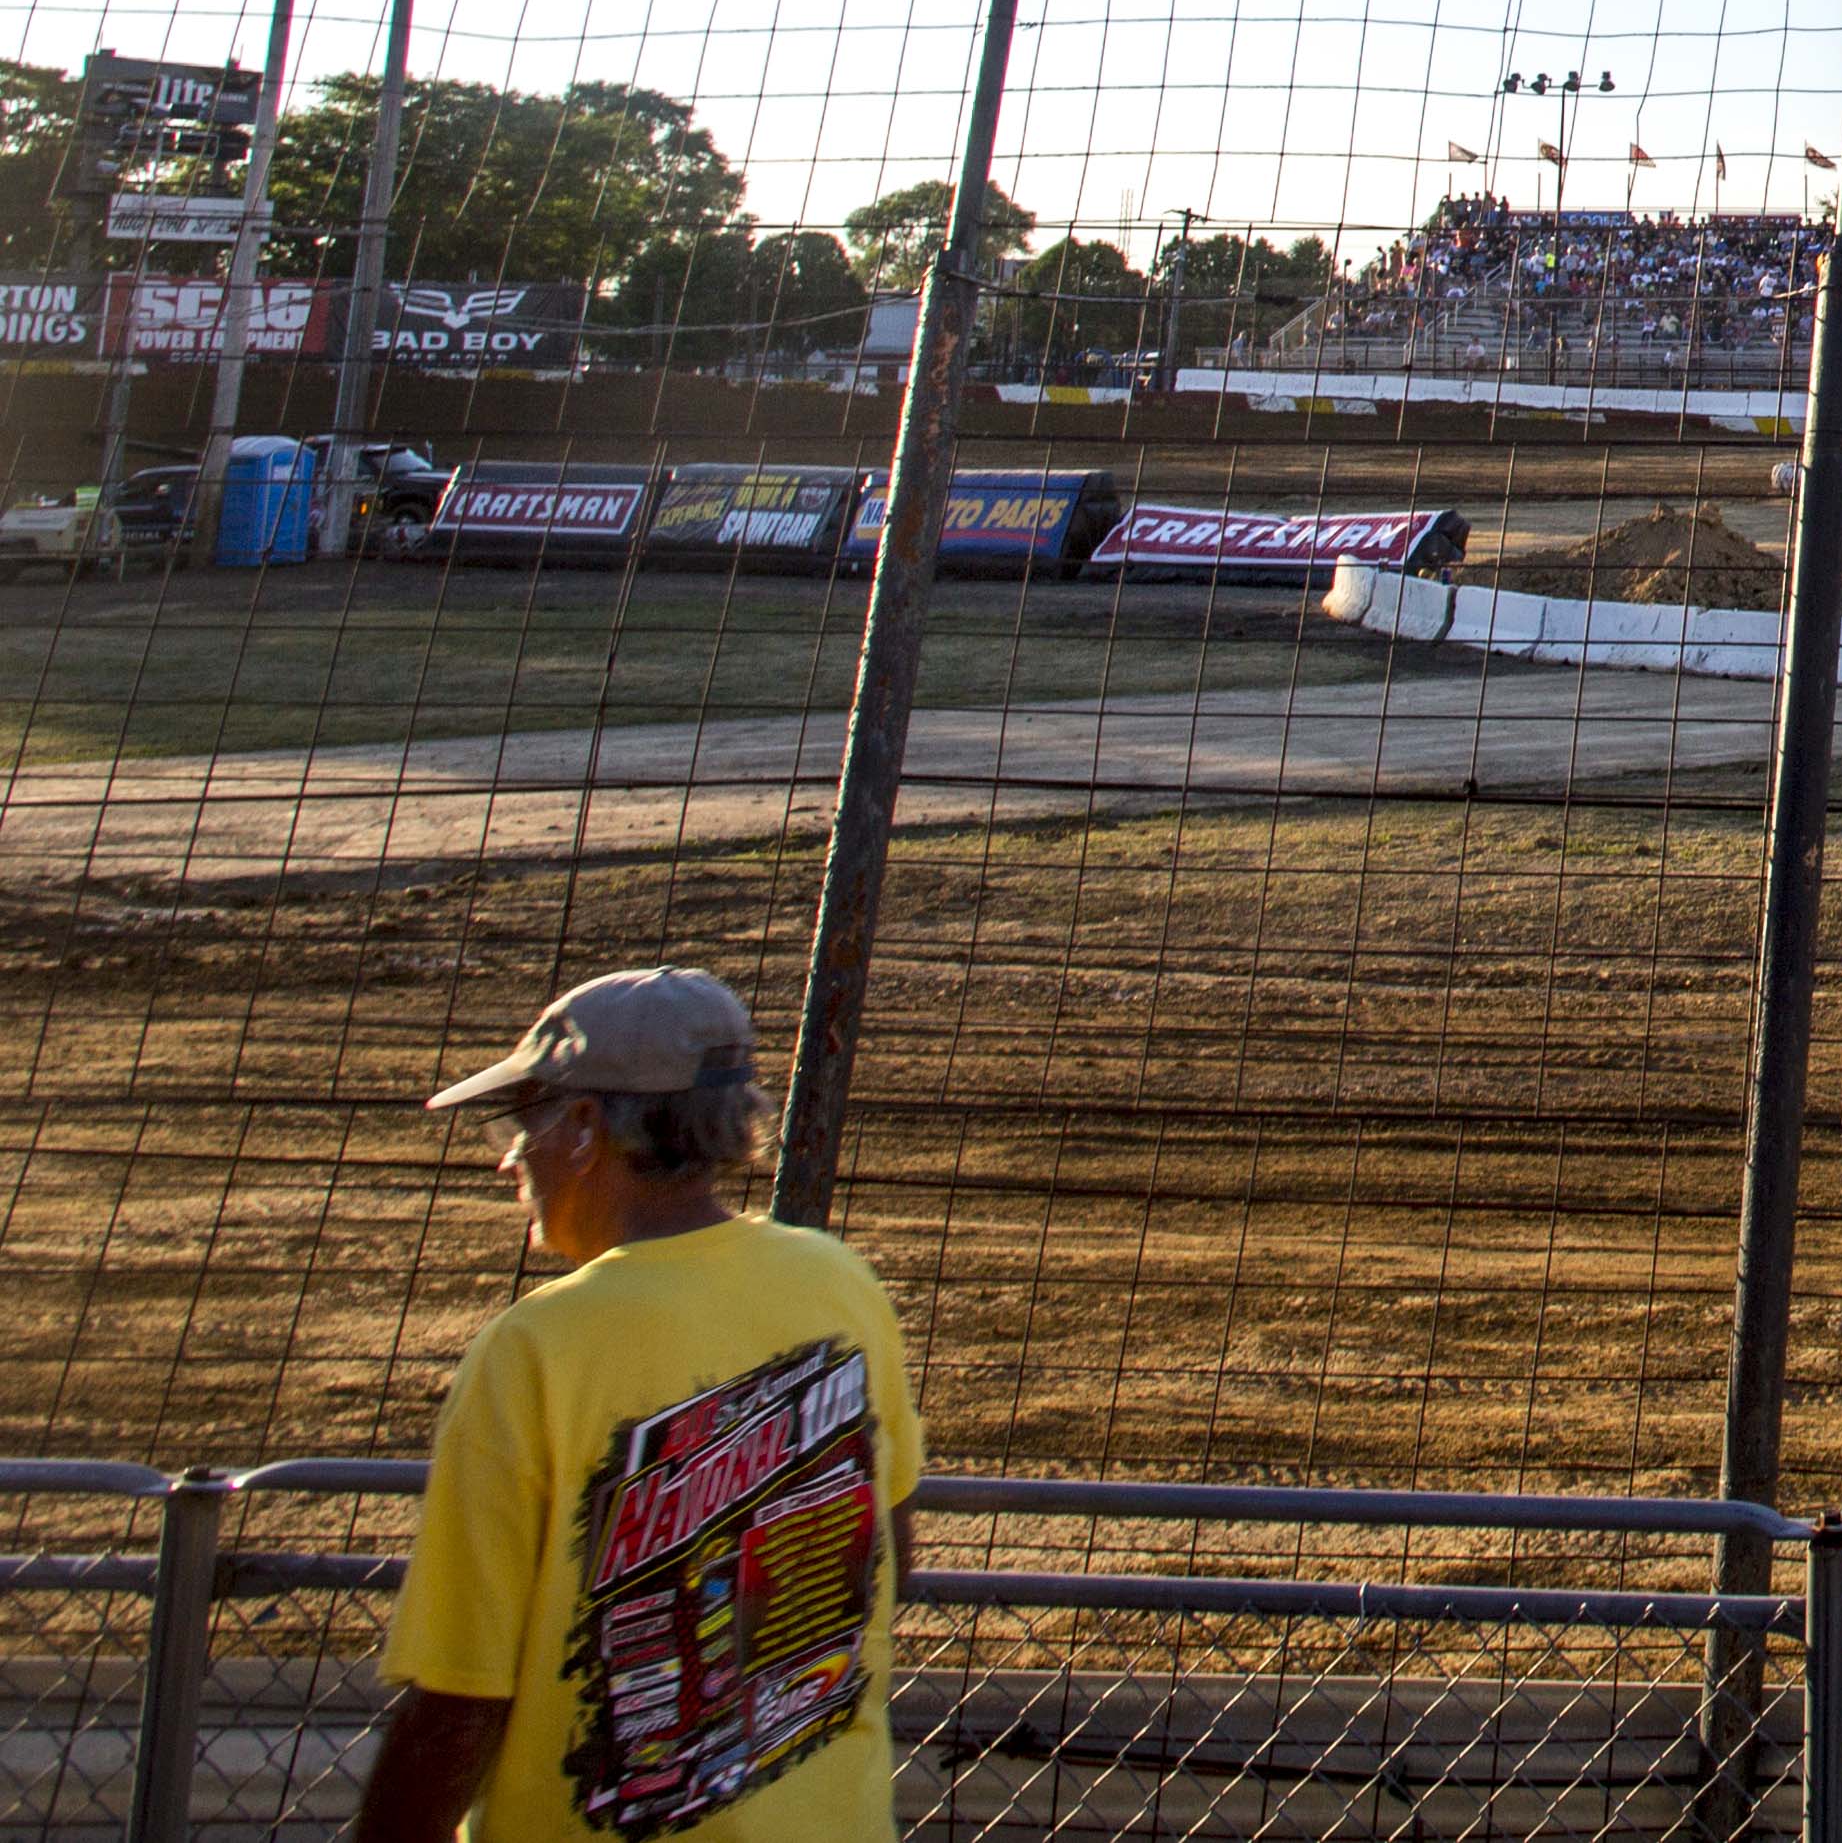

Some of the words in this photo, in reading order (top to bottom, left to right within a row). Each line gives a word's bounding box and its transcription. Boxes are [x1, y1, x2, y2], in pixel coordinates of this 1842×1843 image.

[371, 331, 449, 350] BAD
[463, 332, 545, 351] BOY
[453, 491, 619, 521] CRAFTSMAN
[981, 499, 1069, 529] PARTS
[1122, 517, 1408, 549] CRAFTSMAN
